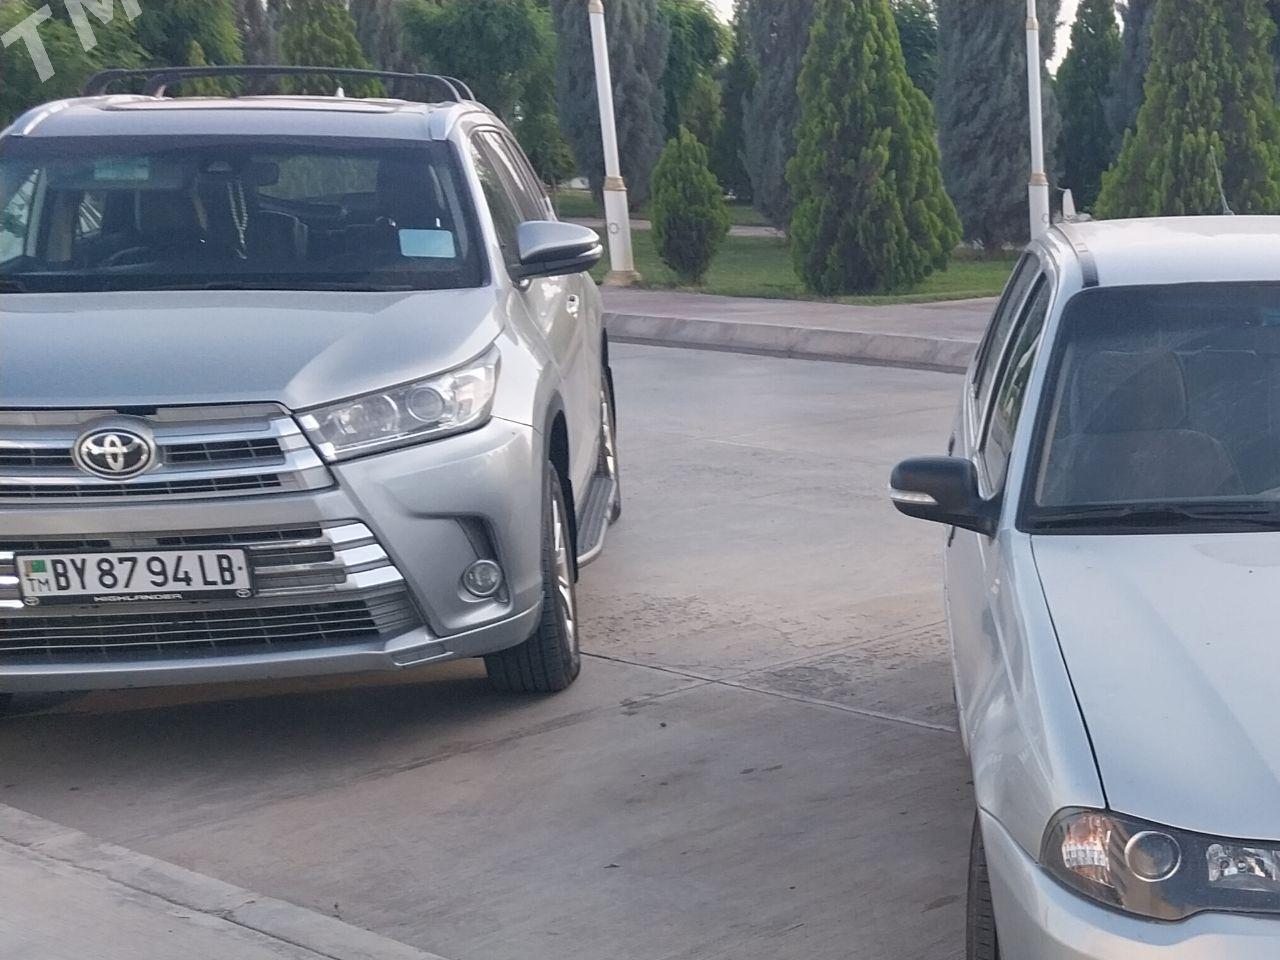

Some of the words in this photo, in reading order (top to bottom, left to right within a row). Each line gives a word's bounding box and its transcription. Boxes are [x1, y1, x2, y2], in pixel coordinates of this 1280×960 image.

[27, 577, 52, 593] TM
[51, 558, 87, 591] BY
[96, 557, 138, 589] 87
[146, 555, 193, 588] 94
[197, 553, 236, 587] LB
